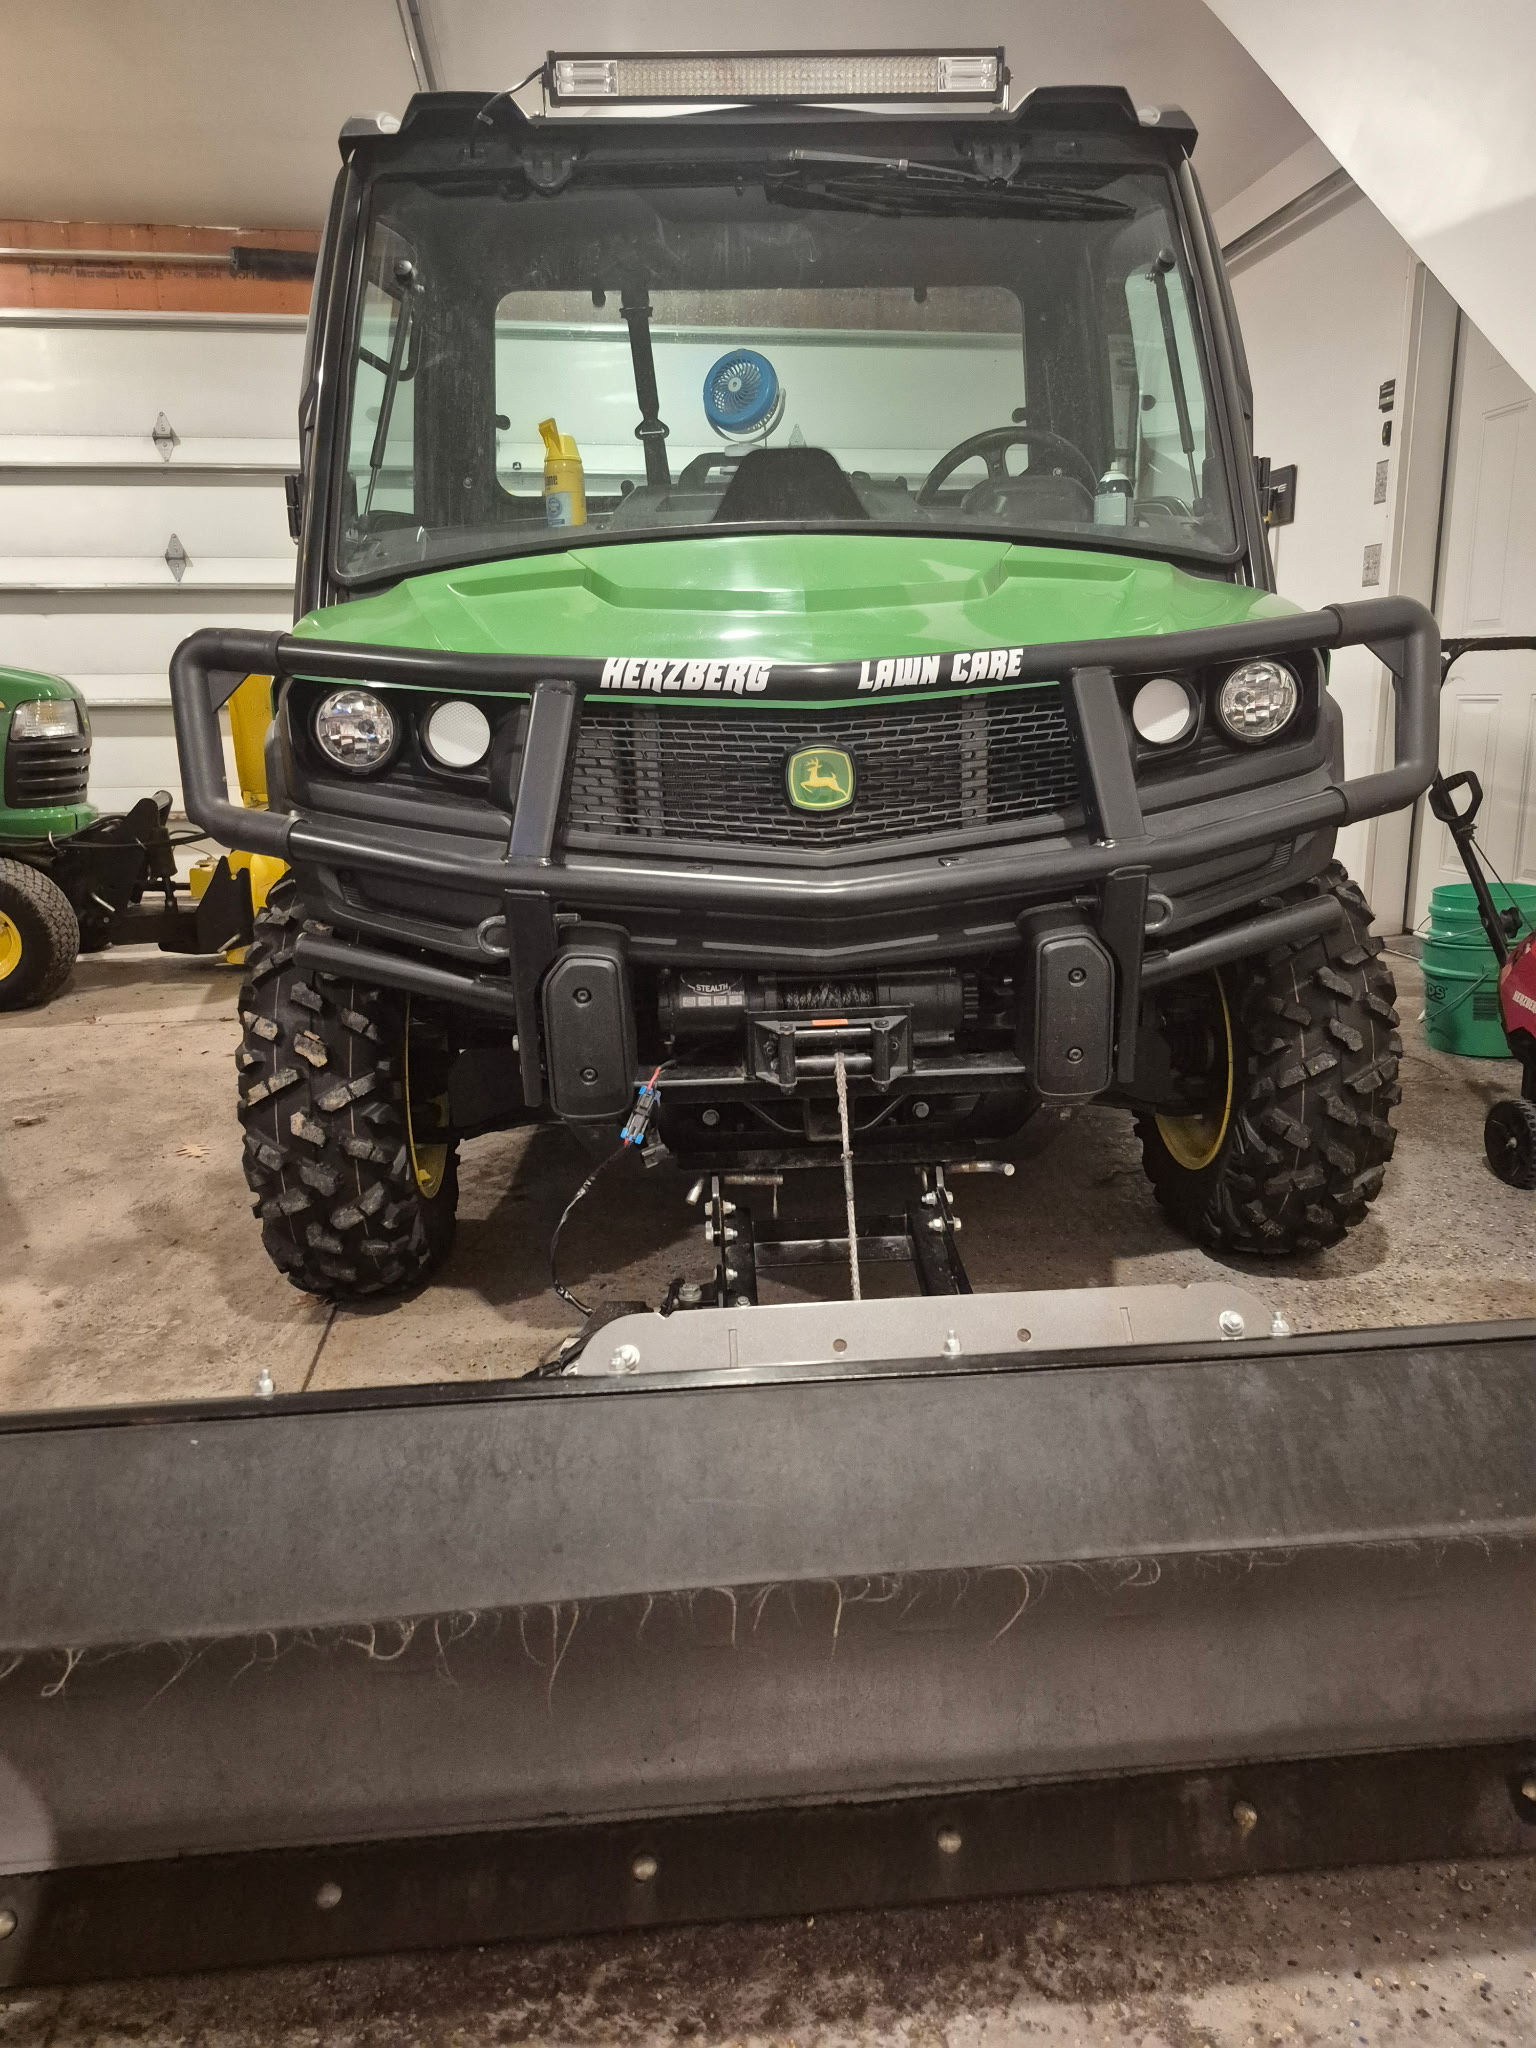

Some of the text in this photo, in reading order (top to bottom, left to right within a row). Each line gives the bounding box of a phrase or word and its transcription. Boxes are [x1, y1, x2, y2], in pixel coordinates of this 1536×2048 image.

[127, 270, 146, 280] LVL
[600, 649, 1023, 695] HERZBERG LAWN CARE
[696, 983, 728, 993] STEALTH
